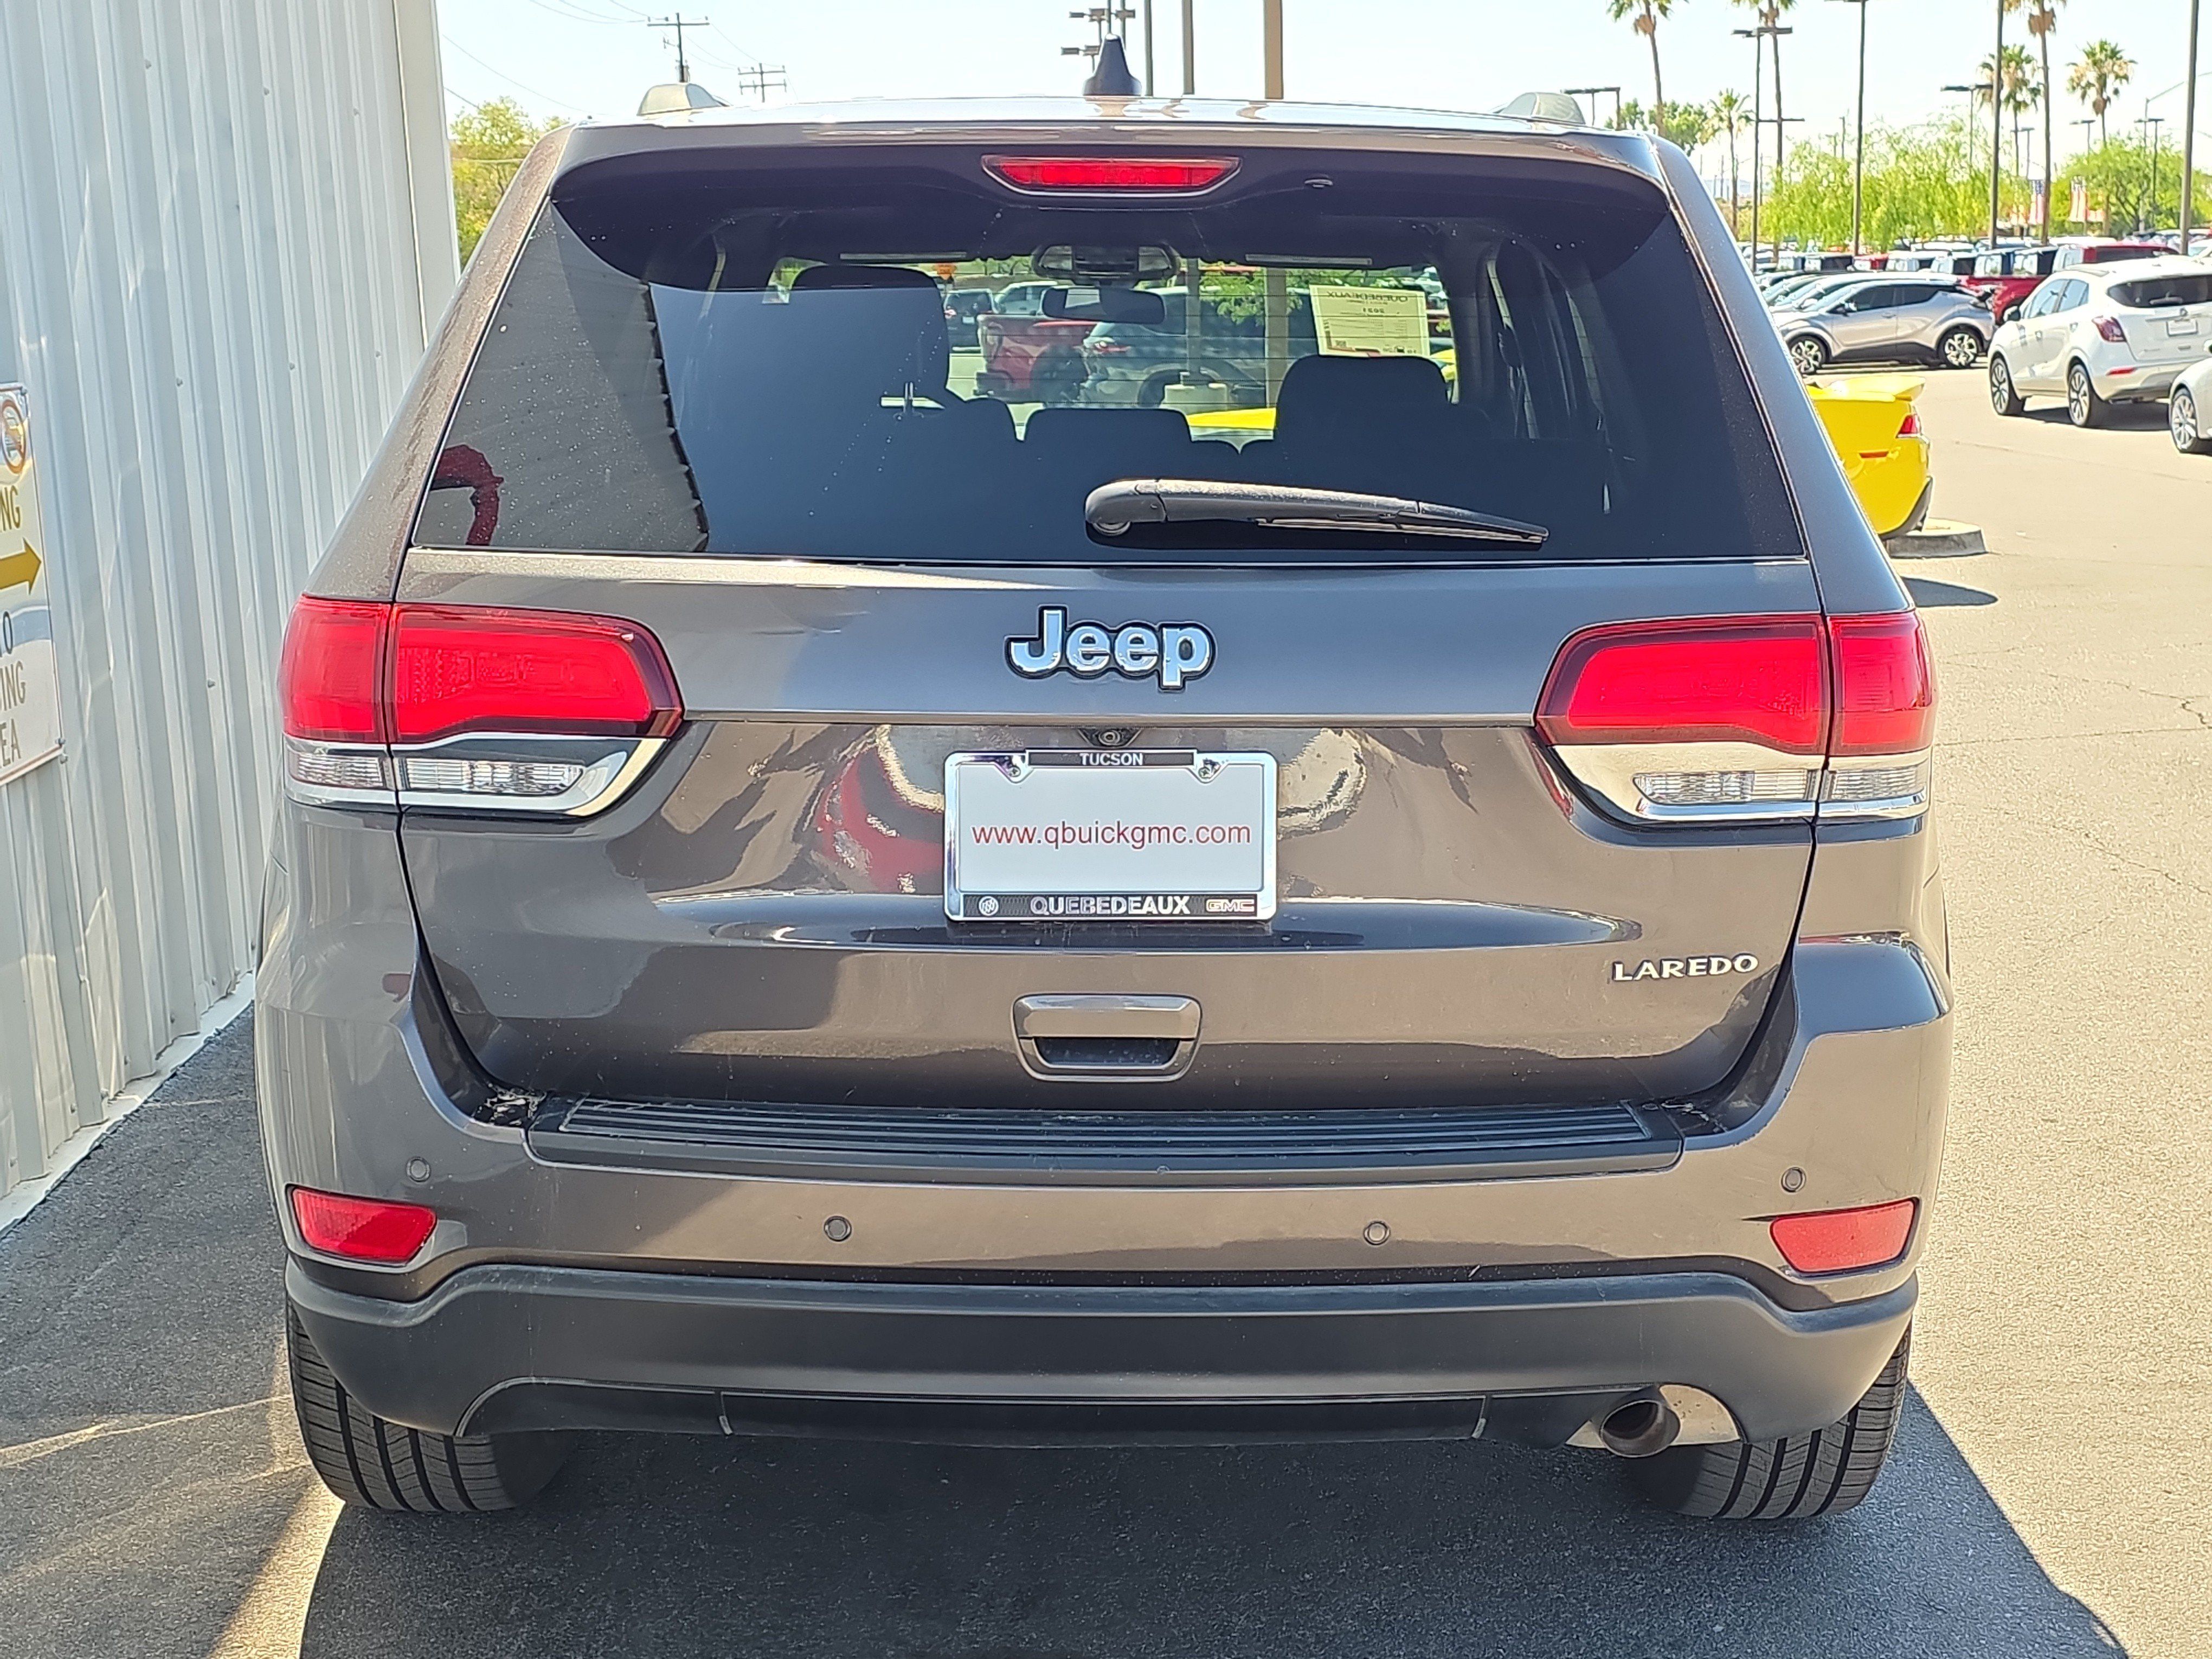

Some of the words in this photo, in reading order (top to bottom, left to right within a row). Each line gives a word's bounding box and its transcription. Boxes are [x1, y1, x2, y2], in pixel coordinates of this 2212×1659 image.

[1007, 607, 1214, 690] Jeep
[1079, 753, 1143, 766] TUCSON
[972, 820, 1251, 850] www.qbuickgmc.com
[1030, 895, 1191, 916] QUEBEDEAUX
[1205, 898, 1255, 912] GMC
[1612, 953, 1759, 981] LAREDO
